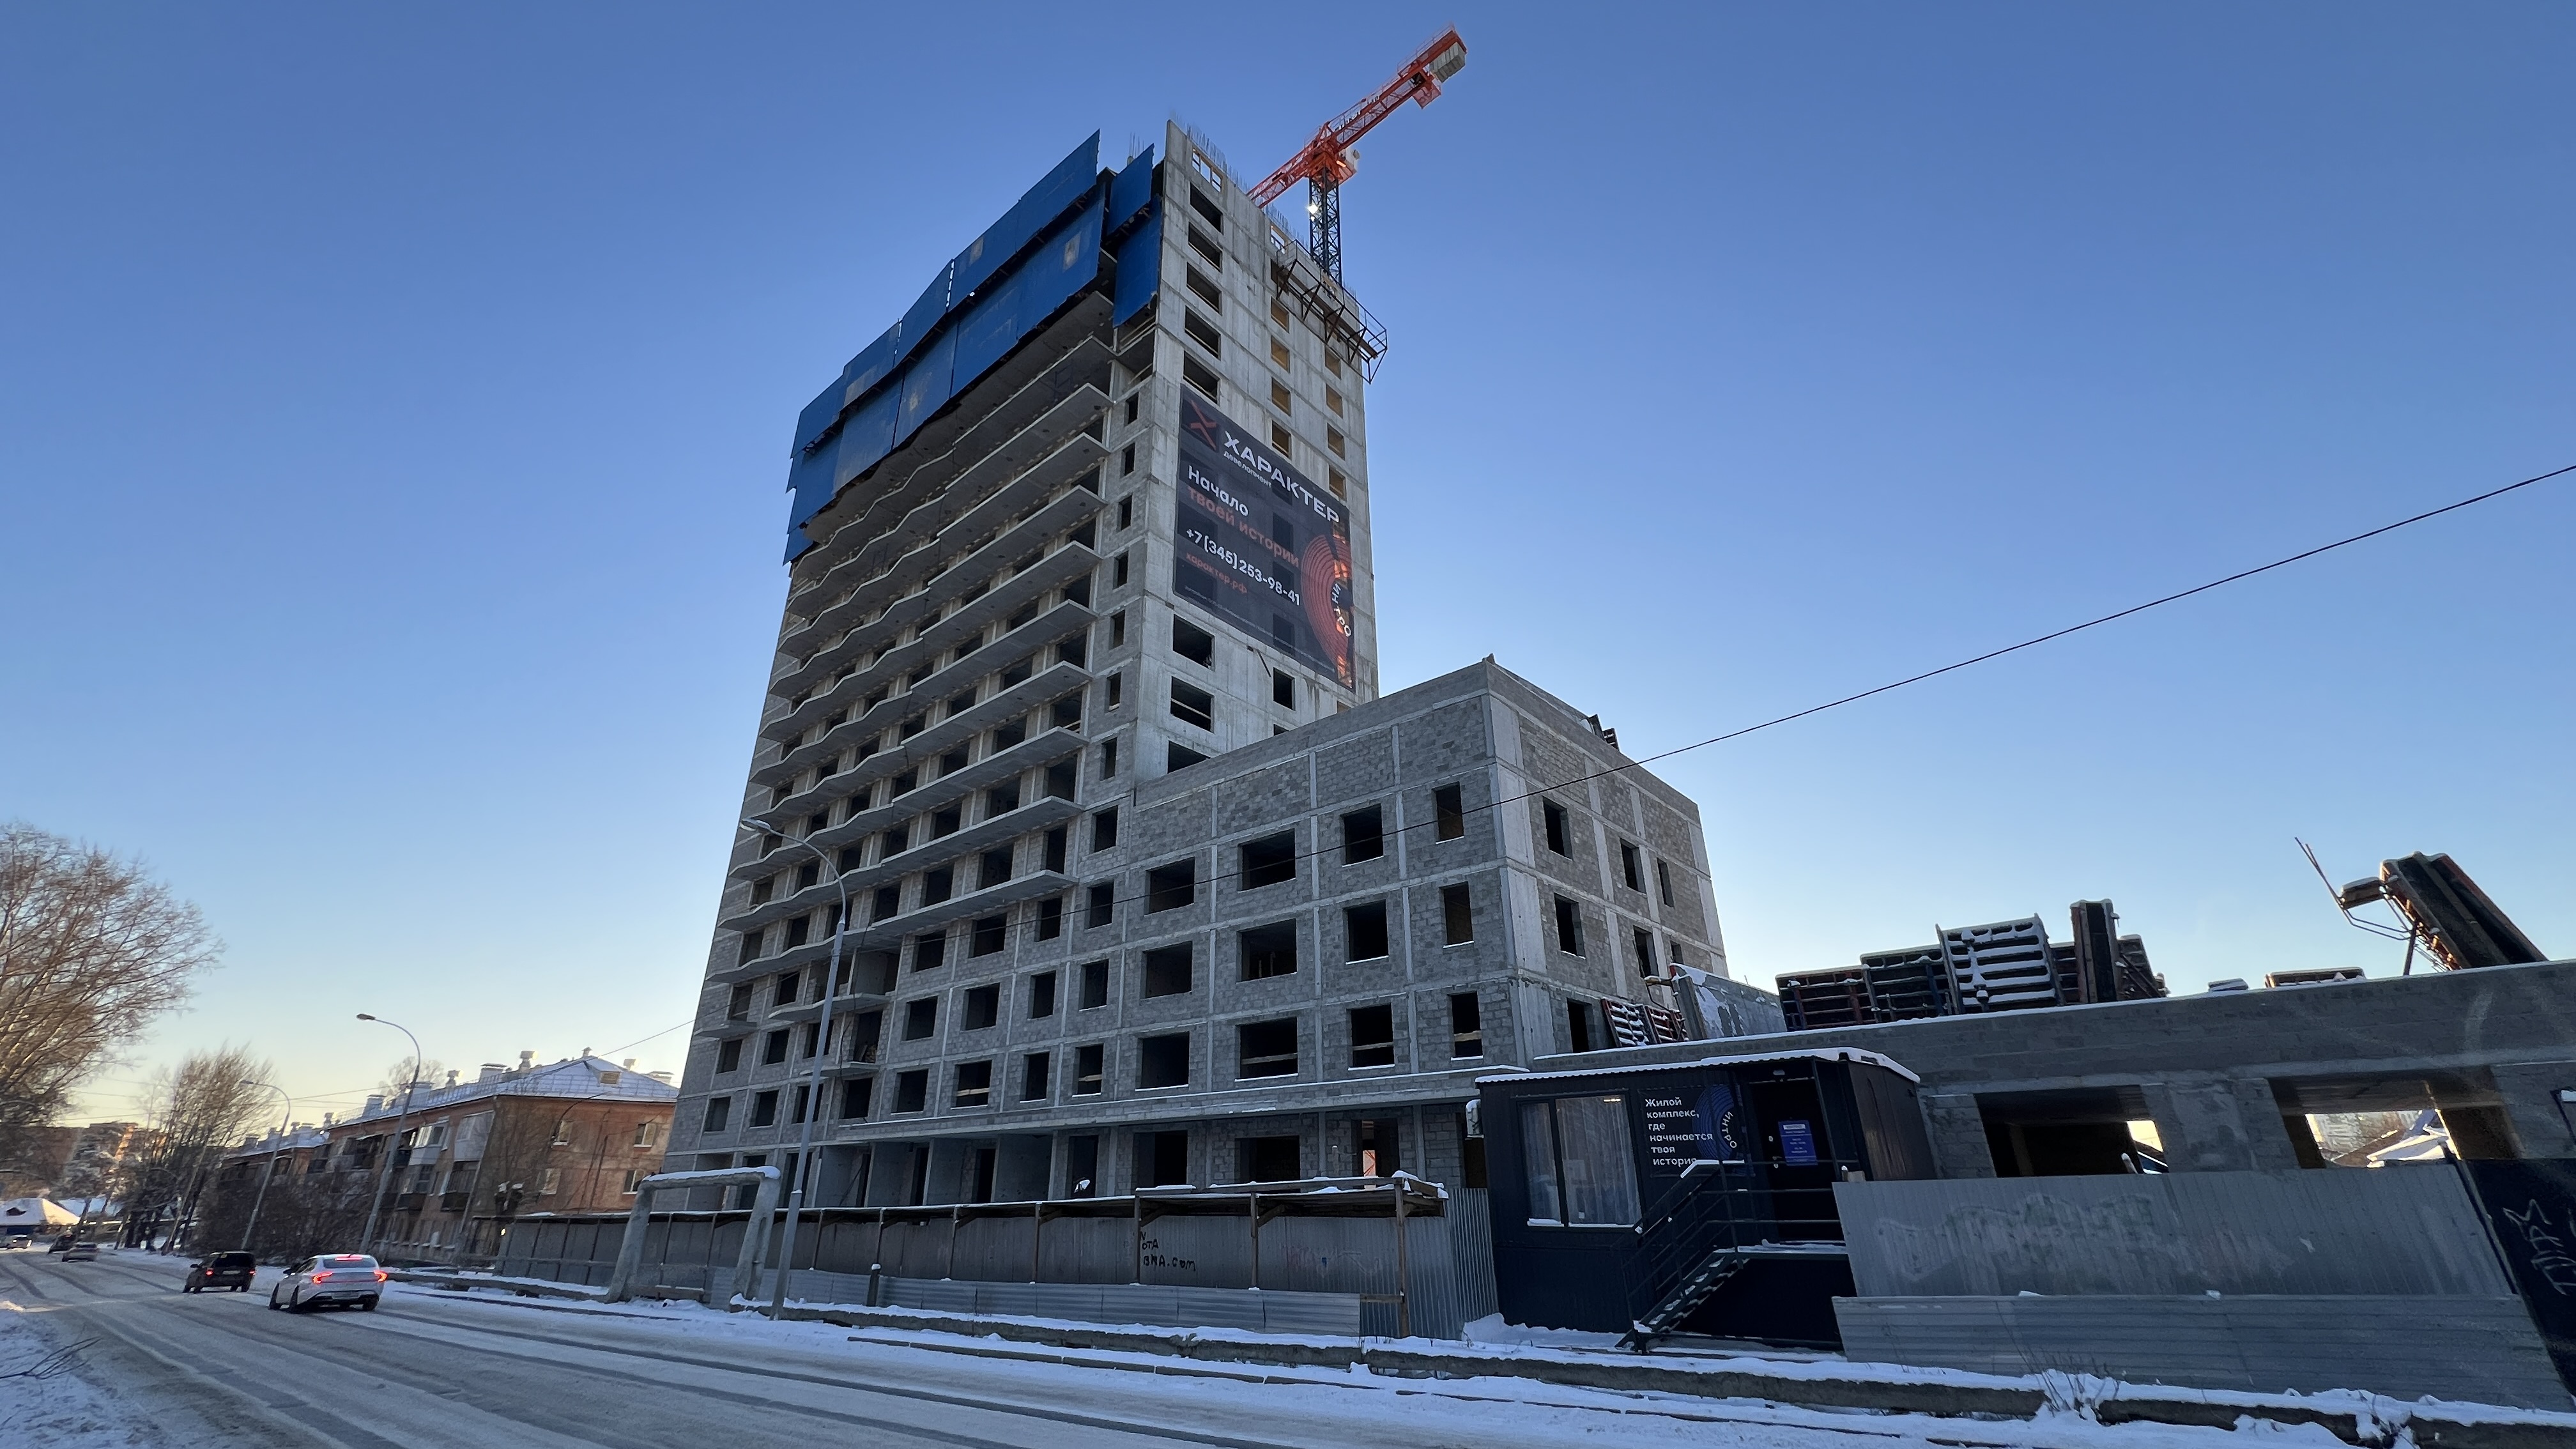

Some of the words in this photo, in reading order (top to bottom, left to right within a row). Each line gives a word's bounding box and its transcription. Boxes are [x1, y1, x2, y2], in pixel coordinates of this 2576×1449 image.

[1188, 465, 1248, 516] Начало
[1224, 431, 1339, 524] ХАРАКТЕР
[1188, 486, 1235, 526] твоей
[1239, 520, 1299, 567] истории
[1185, 552, 1248, 594] характер.рф
[1239, 559, 1300, 606] 253-98-41
[1331, 583, 1352, 637] ИНТРО
[1645, 1096, 1682, 1107] Жилой
[1646, 1110, 1699, 1119] комплекс,
[1648, 1123, 1666, 1131] где
[1650, 1133, 1713, 1142] начинается
[1721, 1111, 1737, 1149] ИНТРО
